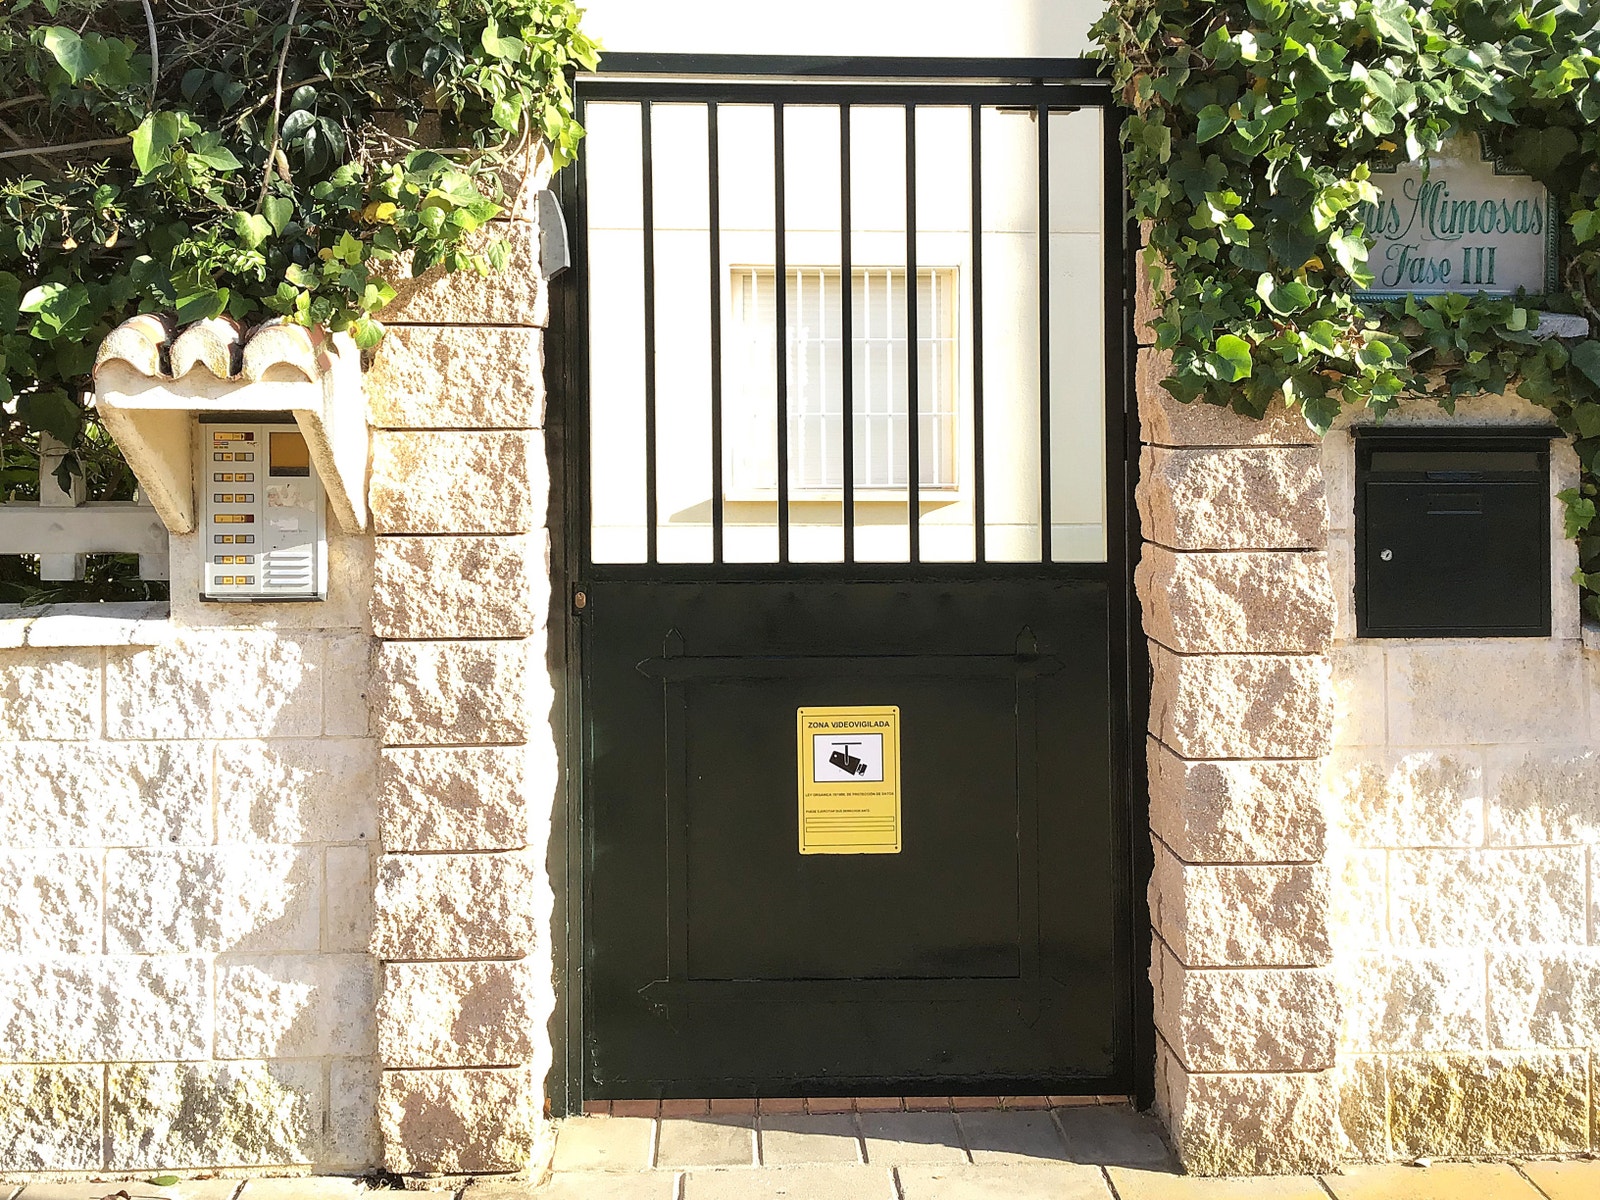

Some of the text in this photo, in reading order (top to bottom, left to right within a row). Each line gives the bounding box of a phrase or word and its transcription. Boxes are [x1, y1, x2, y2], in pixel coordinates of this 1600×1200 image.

[1384, 177, 1544, 241] Mimosas
[1382, 243, 1499, 287] Fase III
[831, 721, 890, 729] VIDEOVIGILADA
